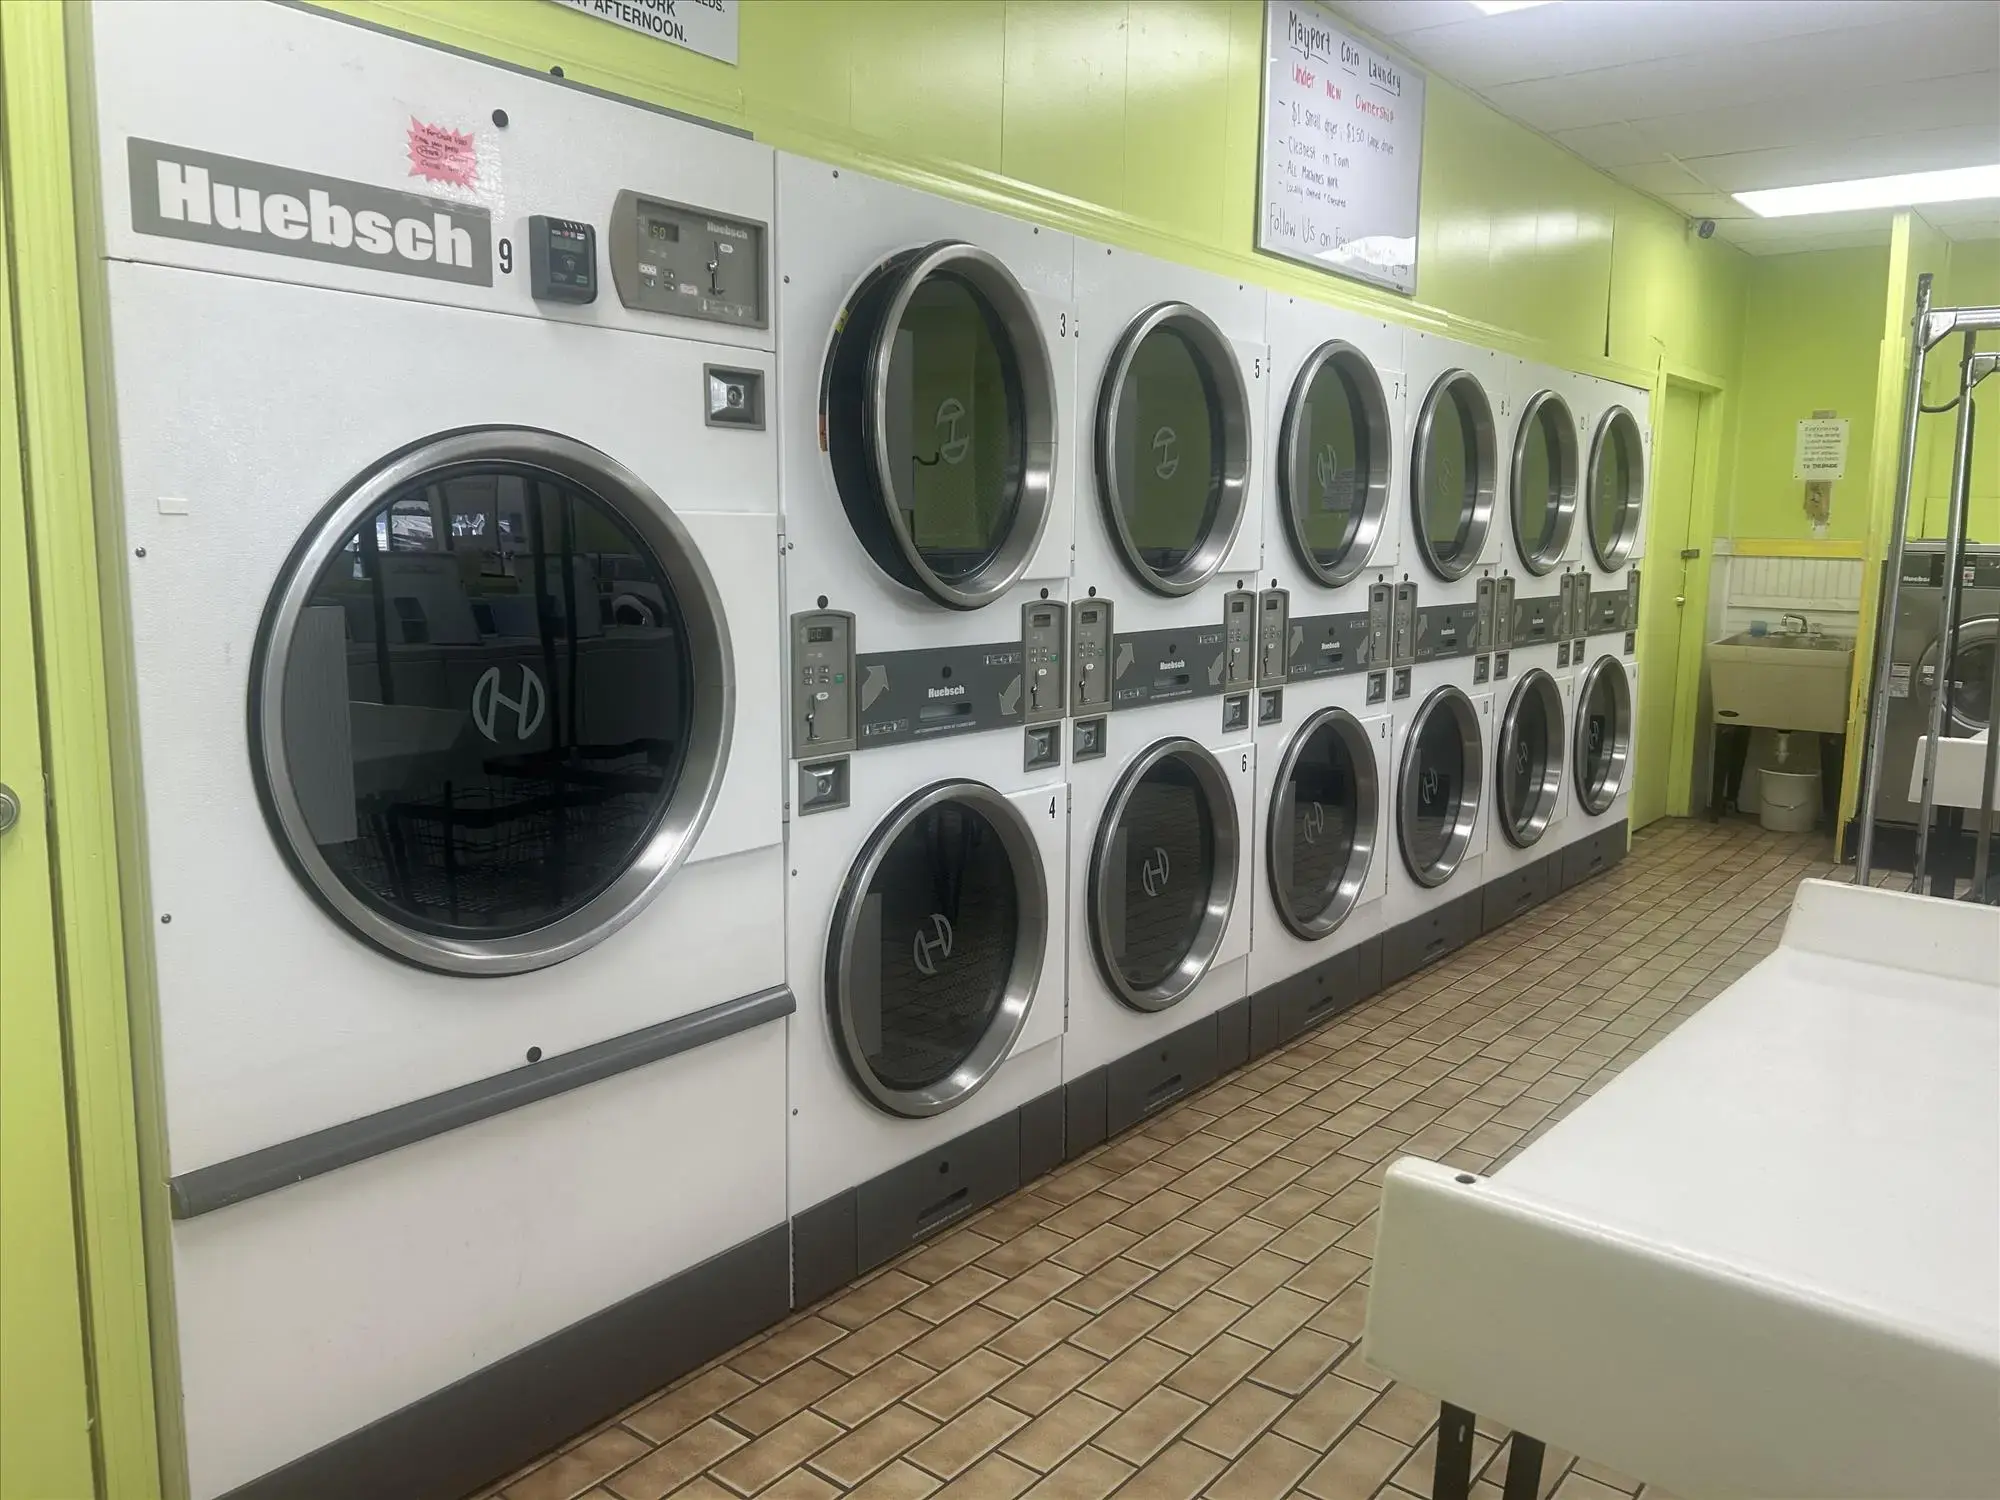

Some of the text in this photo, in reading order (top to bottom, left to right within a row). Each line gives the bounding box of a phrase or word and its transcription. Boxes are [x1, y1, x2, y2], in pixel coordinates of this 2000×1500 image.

[594, 0, 688, 42] AFTERNOON.
[1289, 10, 1400, 97] Mayport Coin Laundry
[1292, 62, 1316, 88] Under
[1322, 154, 1330, 164] in
[157, 159, 472, 268] Huebsch
[1270, 202, 1296, 238] Follow
[1302, 214, 1316, 244] Us
[1320, 232, 1331, 247] on
[706, 221, 748, 240] Huebsch
[499, 238, 512, 274] 9
[1060, 312, 1066, 338] 3
[1254, 358, 1260, 378] 5
[928, 685, 965, 699] Huebsch
[1382, 722, 1386, 738] 8
[1241, 754, 1247, 773] 6
[1048, 796, 1056, 819] 4
